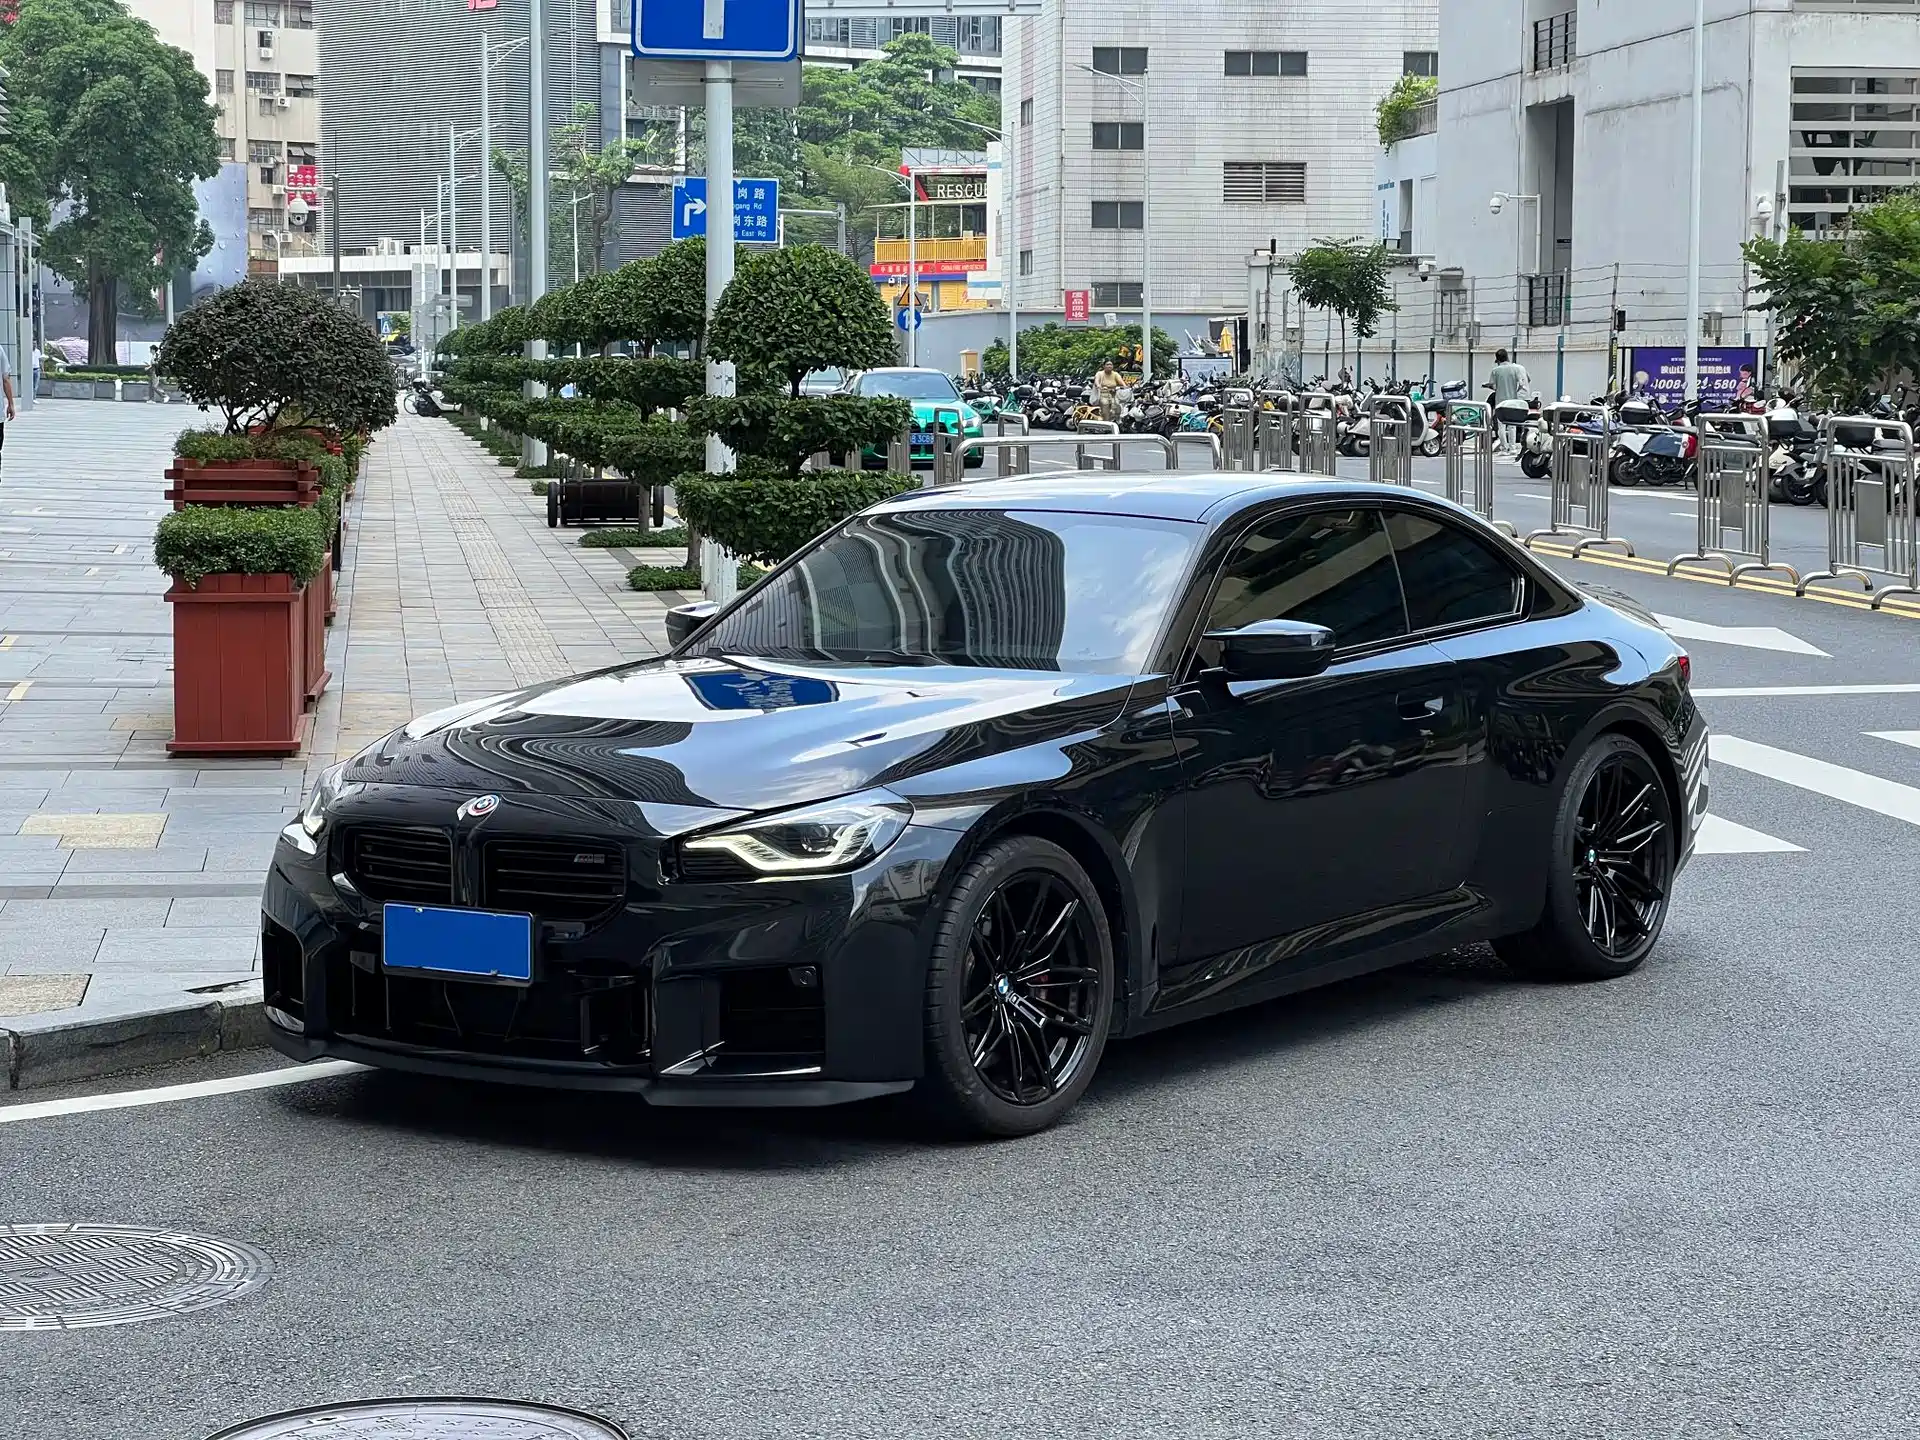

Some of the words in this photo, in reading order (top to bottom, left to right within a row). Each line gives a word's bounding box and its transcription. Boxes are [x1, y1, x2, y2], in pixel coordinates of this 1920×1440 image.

[738, 187, 765, 200] 岗路
[753, 202, 762, 210] Rd
[734, 215, 767, 227] 岗东路
